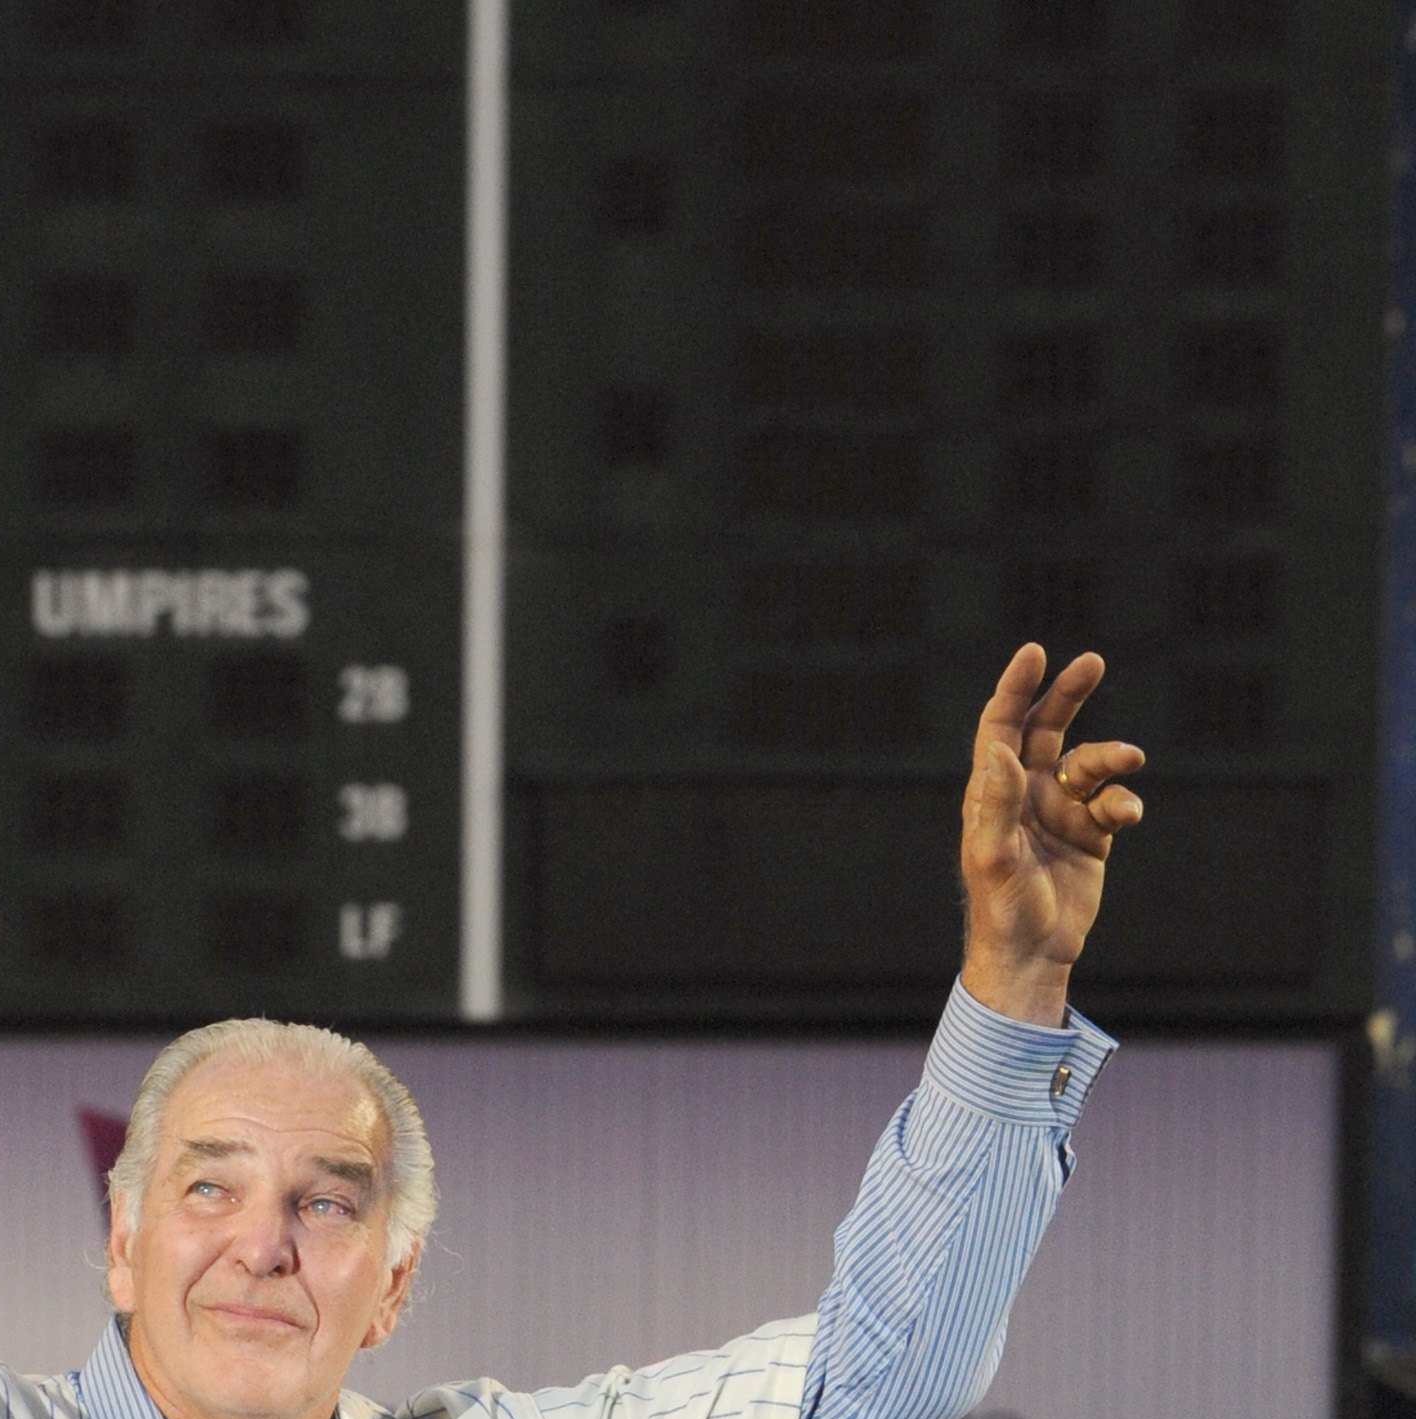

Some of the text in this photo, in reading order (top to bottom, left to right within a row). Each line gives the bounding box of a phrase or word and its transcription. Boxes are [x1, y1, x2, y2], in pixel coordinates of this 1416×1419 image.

[31, 568, 310, 638] UMPIRES
[337, 664, 410, 723] 2B
[337, 782, 409, 841] 3B
[338, 901, 402, 958] LF
